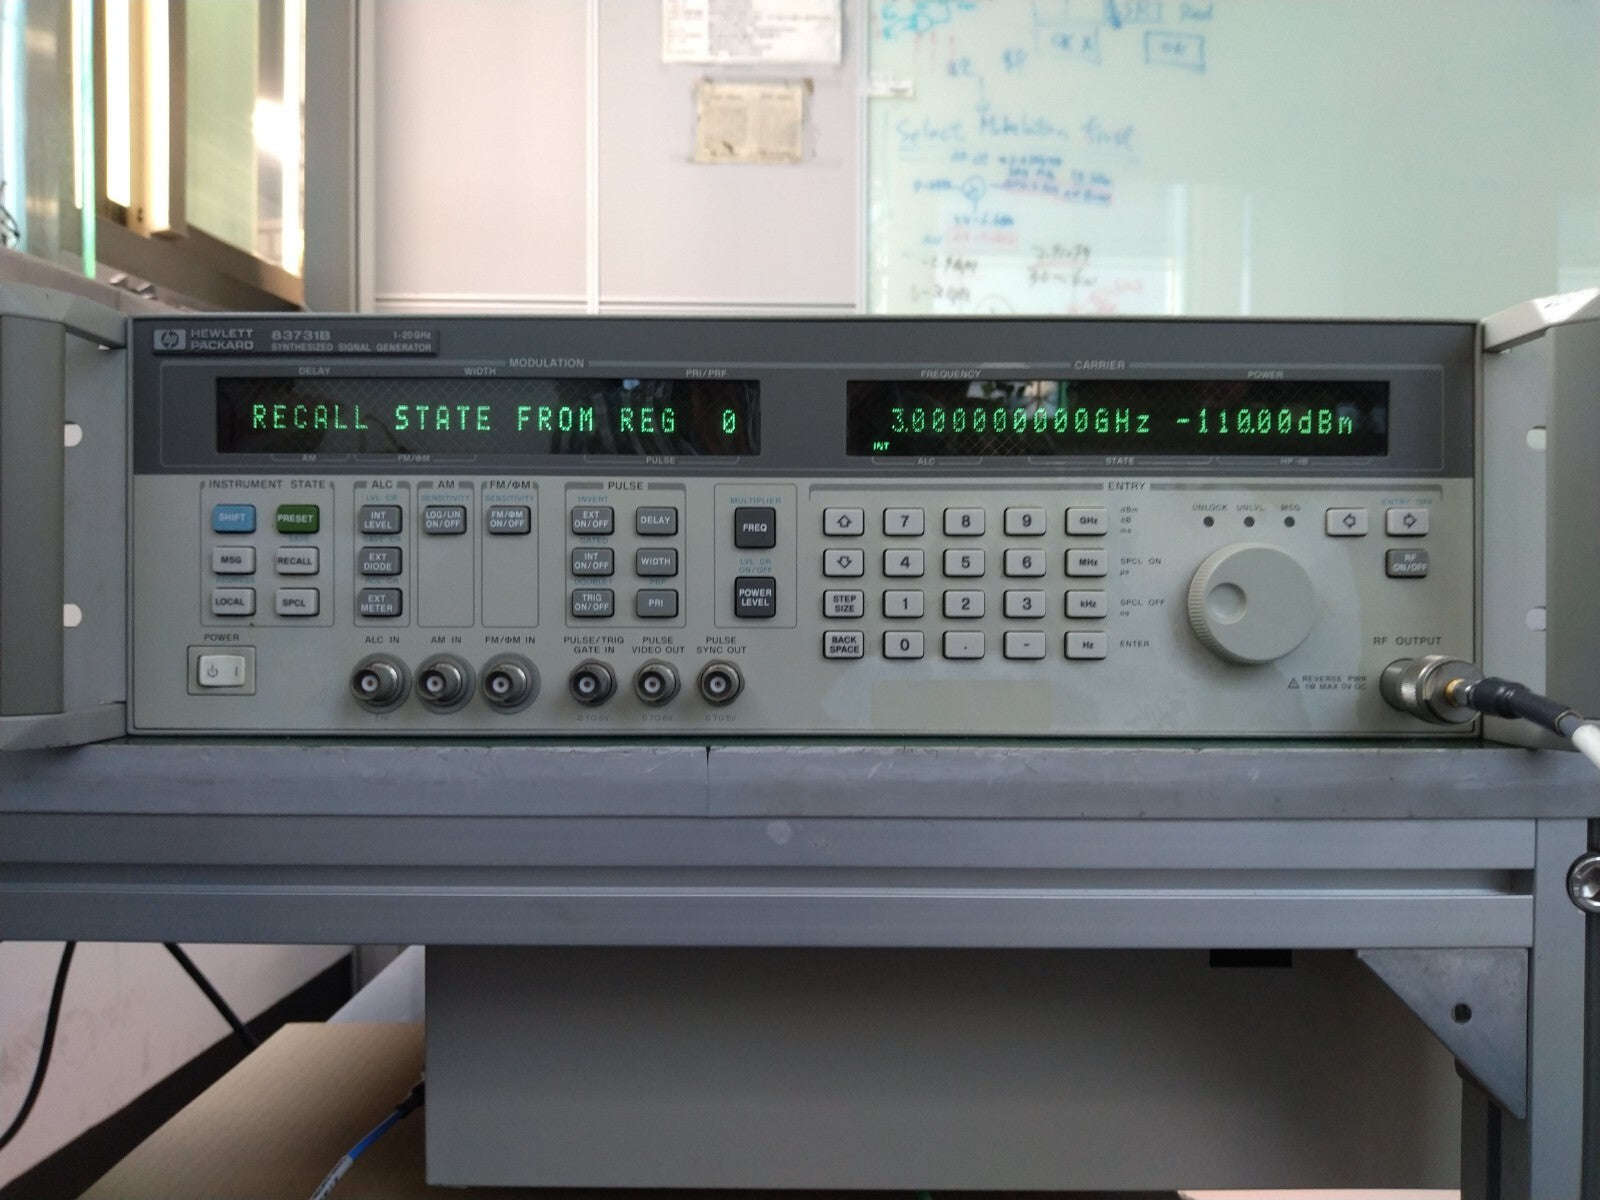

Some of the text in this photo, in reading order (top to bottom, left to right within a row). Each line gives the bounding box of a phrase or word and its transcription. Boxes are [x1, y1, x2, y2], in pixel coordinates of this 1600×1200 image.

[190, 329, 253, 338] HEWLETT
[272, 330, 331, 340] 83731B
[190, 341, 253, 350] PACKARD
[272, 343, 432, 352] SYNTHESIZED SIGNAL GENERATOR
[509, 358, 584, 368] MODULATION
[1075, 361, 1125, 370] CARRIER
[299, 367, 331, 375] DELAY
[921, 370, 982, 379] FREQUENCY
[1248, 371, 1284, 379] POWER
[253, 403, 737, 434] RECALL STATE FROM REG 0
[873, 441, 890, 450] INT
[302, 454, 316, 462] AM
[917, 457, 935, 465] ALC
[1105, 457, 1135, 465] STATE
[209, 480, 325, 488] INSTRUMENT STATE
[372, 480, 393, 488] ALC
[608, 482, 644, 490] PULSE
[1108, 482, 1145, 491] ENTRY
[278, 514, 313, 523] PRESET
[426, 511, 461, 519] LOG/LIN
[583, 511, 600, 519] EXT
[426, 520, 460, 528] ON/OFF
[641, 516, 670, 524] DELAY
[900, 515, 910, 527] 7
[961, 515, 971, 527] 8
[1022, 514, 1032, 527] 9
[1080, 517, 1098, 525] GHz
[364, 521, 392, 529] LEVEL
[743, 524, 767, 532] FREQ
[221, 556, 241, 564] MSG
[278, 557, 312, 565] RECALL
[369, 553, 387, 561] EXT
[1404, 554, 1417, 562] RF
[574, 561, 609, 569] ON/OFF
[900, 556, 910, 568] 4
[961, 556, 970, 568] 5
[1022, 556, 1032, 568] 6
[1079, 558, 1098, 566] MHz
[364, 563, 392, 571] DIODE
[738, 566, 772, 574] ON/OFF
[1393, 562, 1428, 572] ON/OFF
[739, 589, 771, 597] POWER
[216, 598, 244, 606] LOCAL
[582, 594, 602, 602] TRIG
[741, 598, 769, 606] LEVEL
[833, 595, 856, 603] STEP
[282, 599, 305, 608] SPCL
[575, 603, 609, 611] ON/OFF
[648, 599, 663, 607] PRI
[902, 598, 908, 609] 1
[961, 598, 970, 610] 2
[1022, 598, 1032, 610] 3
[1080, 600, 1097, 608] kHz
[361, 604, 393, 612] METER
[835, 605, 854, 613] SIZE
[365, 636, 399, 644] ALC IN
[431, 636, 462, 644] AM IN
[526, 636, 536, 644] IN
[832, 636, 856, 644] BACK
[1373, 636, 1441, 646] RF OUTPUT
[830, 645, 859, 653] SPACE
[900, 639, 909, 651] 0
[1082, 641, 1094, 649] Hz
[574, 646, 615, 654] GATE IN
[631, 646, 685, 654] VIDEO OUT
[696, 646, 746, 654] SYNC OUT
